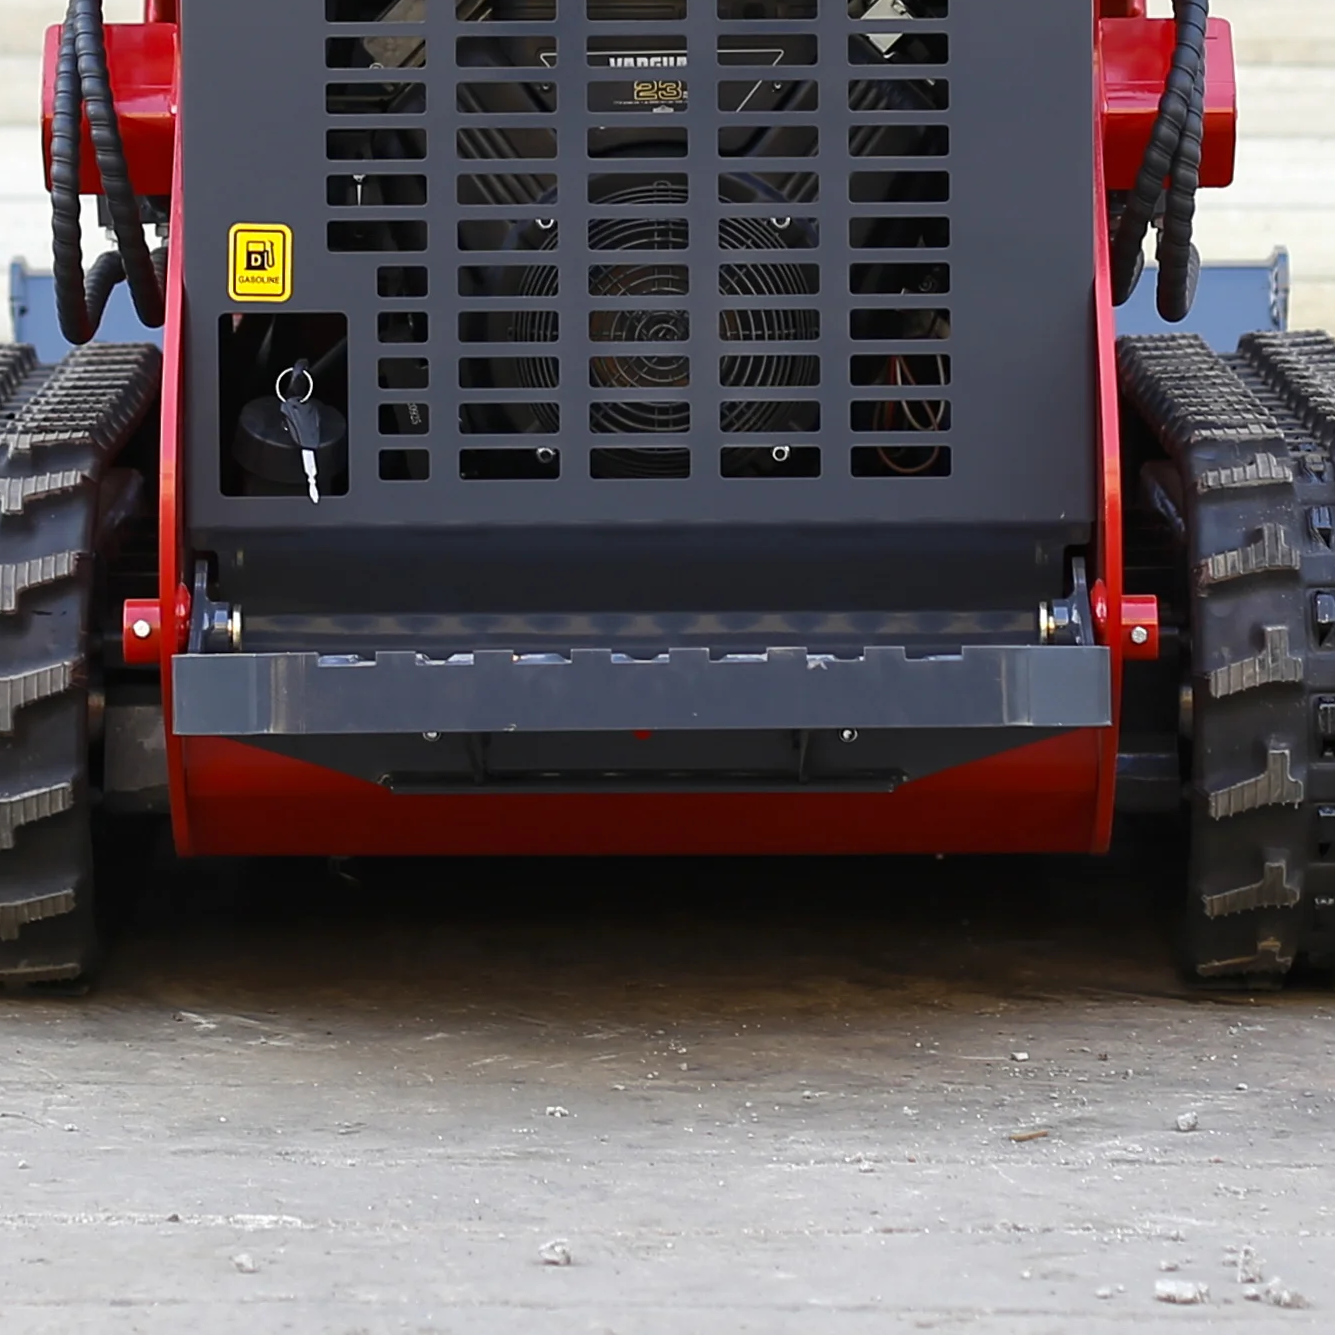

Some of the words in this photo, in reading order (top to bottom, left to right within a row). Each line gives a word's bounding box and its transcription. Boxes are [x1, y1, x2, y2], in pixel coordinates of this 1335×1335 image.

[609, 56, 687, 67] VANGUA
[634, 80, 682, 100] 23
[251, 253, 262, 266] D
[238, 276, 279, 284] GASOLINE
